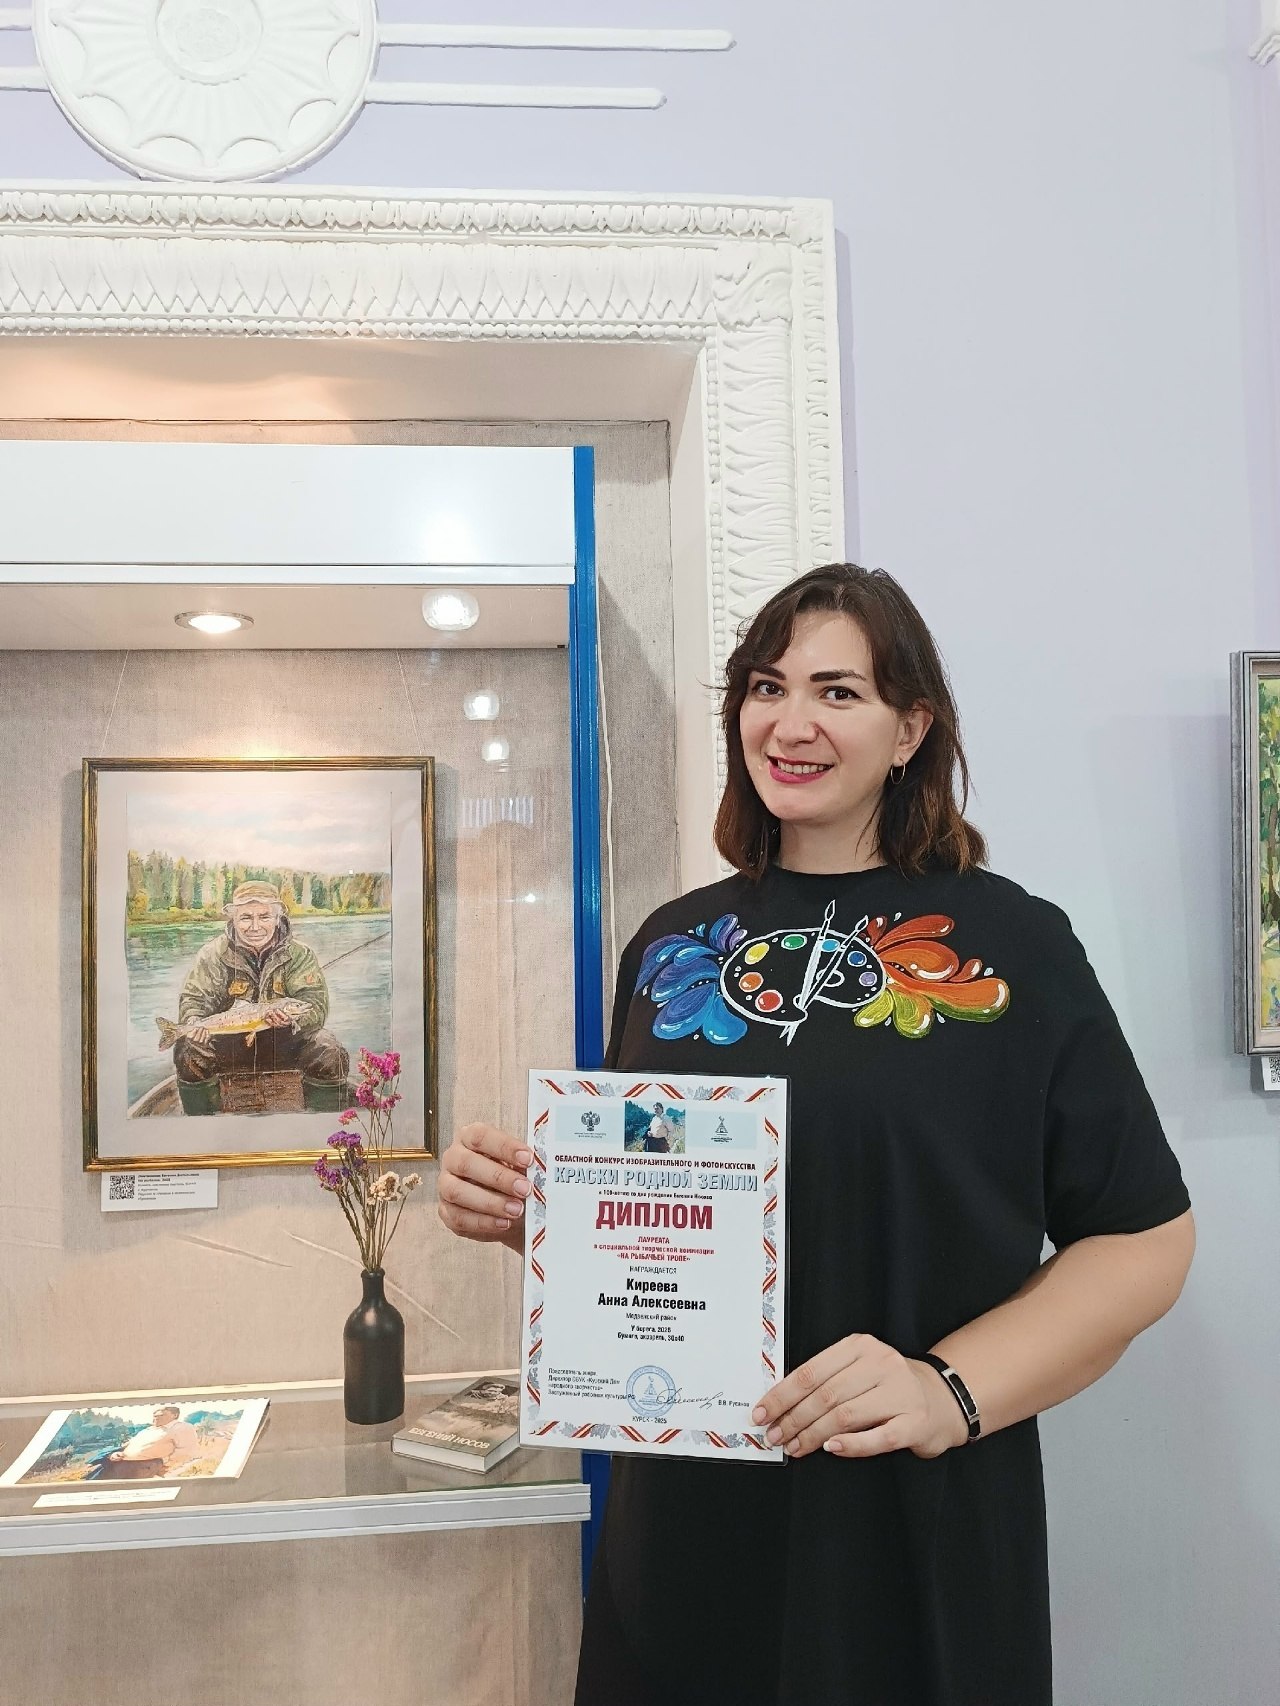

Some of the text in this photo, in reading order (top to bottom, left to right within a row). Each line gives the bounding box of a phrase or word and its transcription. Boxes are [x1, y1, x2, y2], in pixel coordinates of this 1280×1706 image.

[554, 1154, 593, 1164] ОБЛАСТНОЙ
[594, 1156, 625, 1165] КОНКУРС
[625, 1158, 693, 1168] ИЗОБРАЗИТЕЛЬНОГО
[700, 1161, 756, 1171] ФОТОИСКУССТВА
[554, 1166, 758, 1192] КРАСКИ РОДНОЙ ЗЕМЛИ
[595, 1200, 713, 1230] ДИПЛОМ
[638, 1236, 670, 1244] ЛАУРЕАТА
[599, 1244, 640, 1252] специальной
[642, 1246, 678, 1254] творческой
[630, 1253, 665, 1262] РЫБАЧЬЕЙ
[629, 1266, 677, 1275] НАГРАЖДАЕТСЯ
[626, 1278, 678, 1293] Киреева
[598, 1293, 706, 1310] Анна Алексеевна
[408, 1427, 490, 1449] ЕВГЕНИЙ НОСОВ
